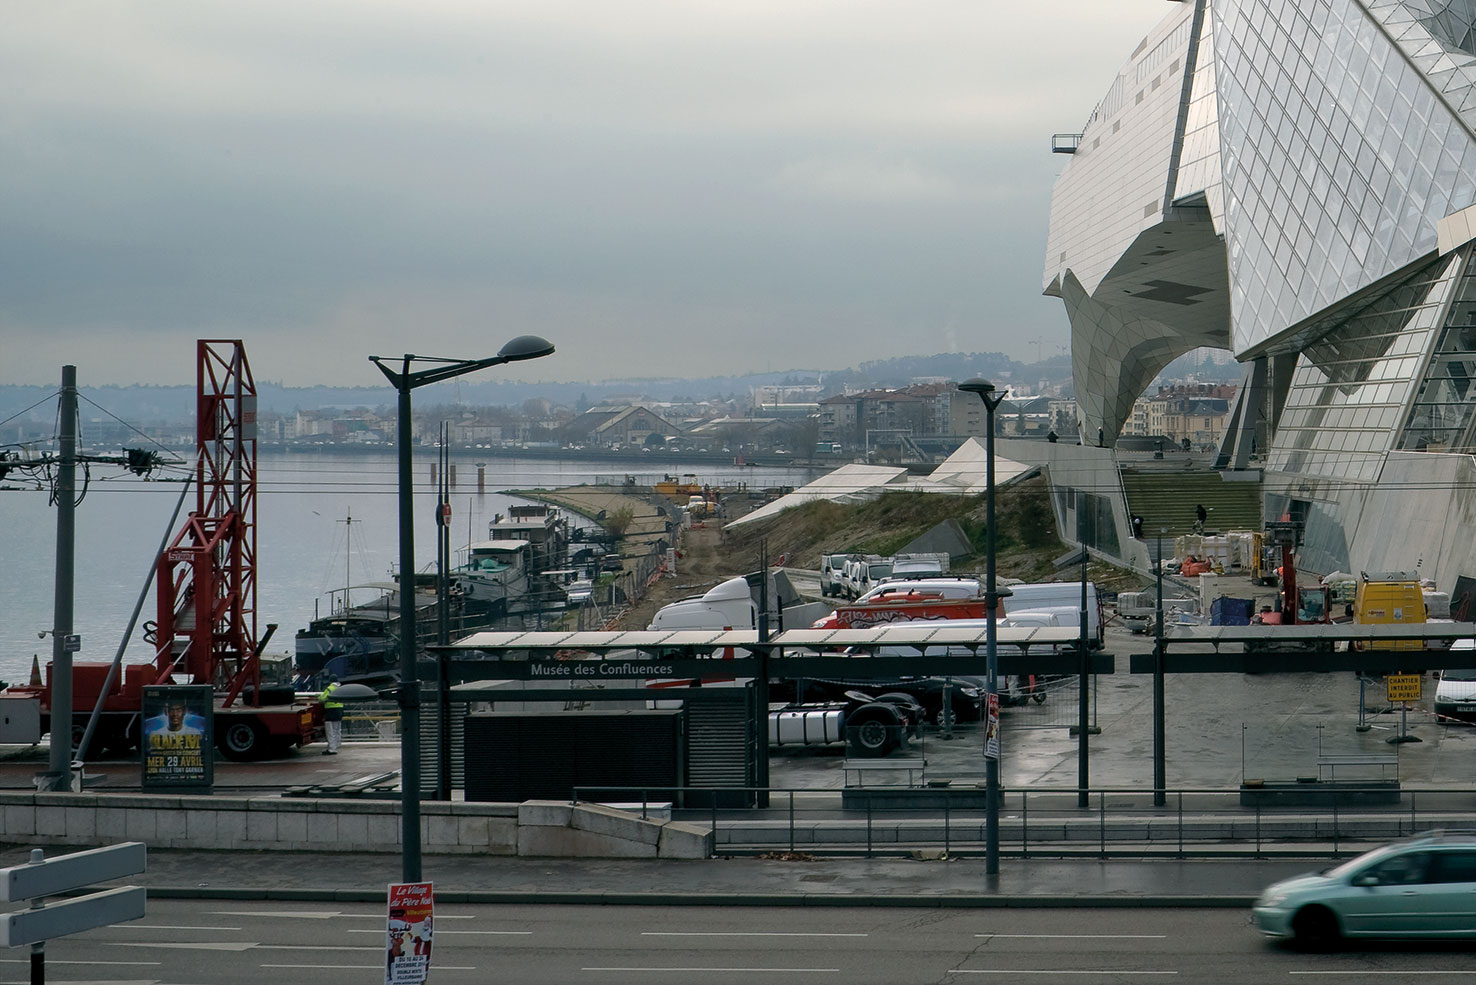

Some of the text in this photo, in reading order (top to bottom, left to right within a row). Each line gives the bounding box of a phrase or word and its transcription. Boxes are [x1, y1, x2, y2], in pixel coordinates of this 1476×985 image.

[531, 663, 673, 675] Musée des Confluences
[147, 756, 203, 767] MER 29 AVRIL
[396, 886, 407, 896] Le
[401, 897, 420, 907] Père
